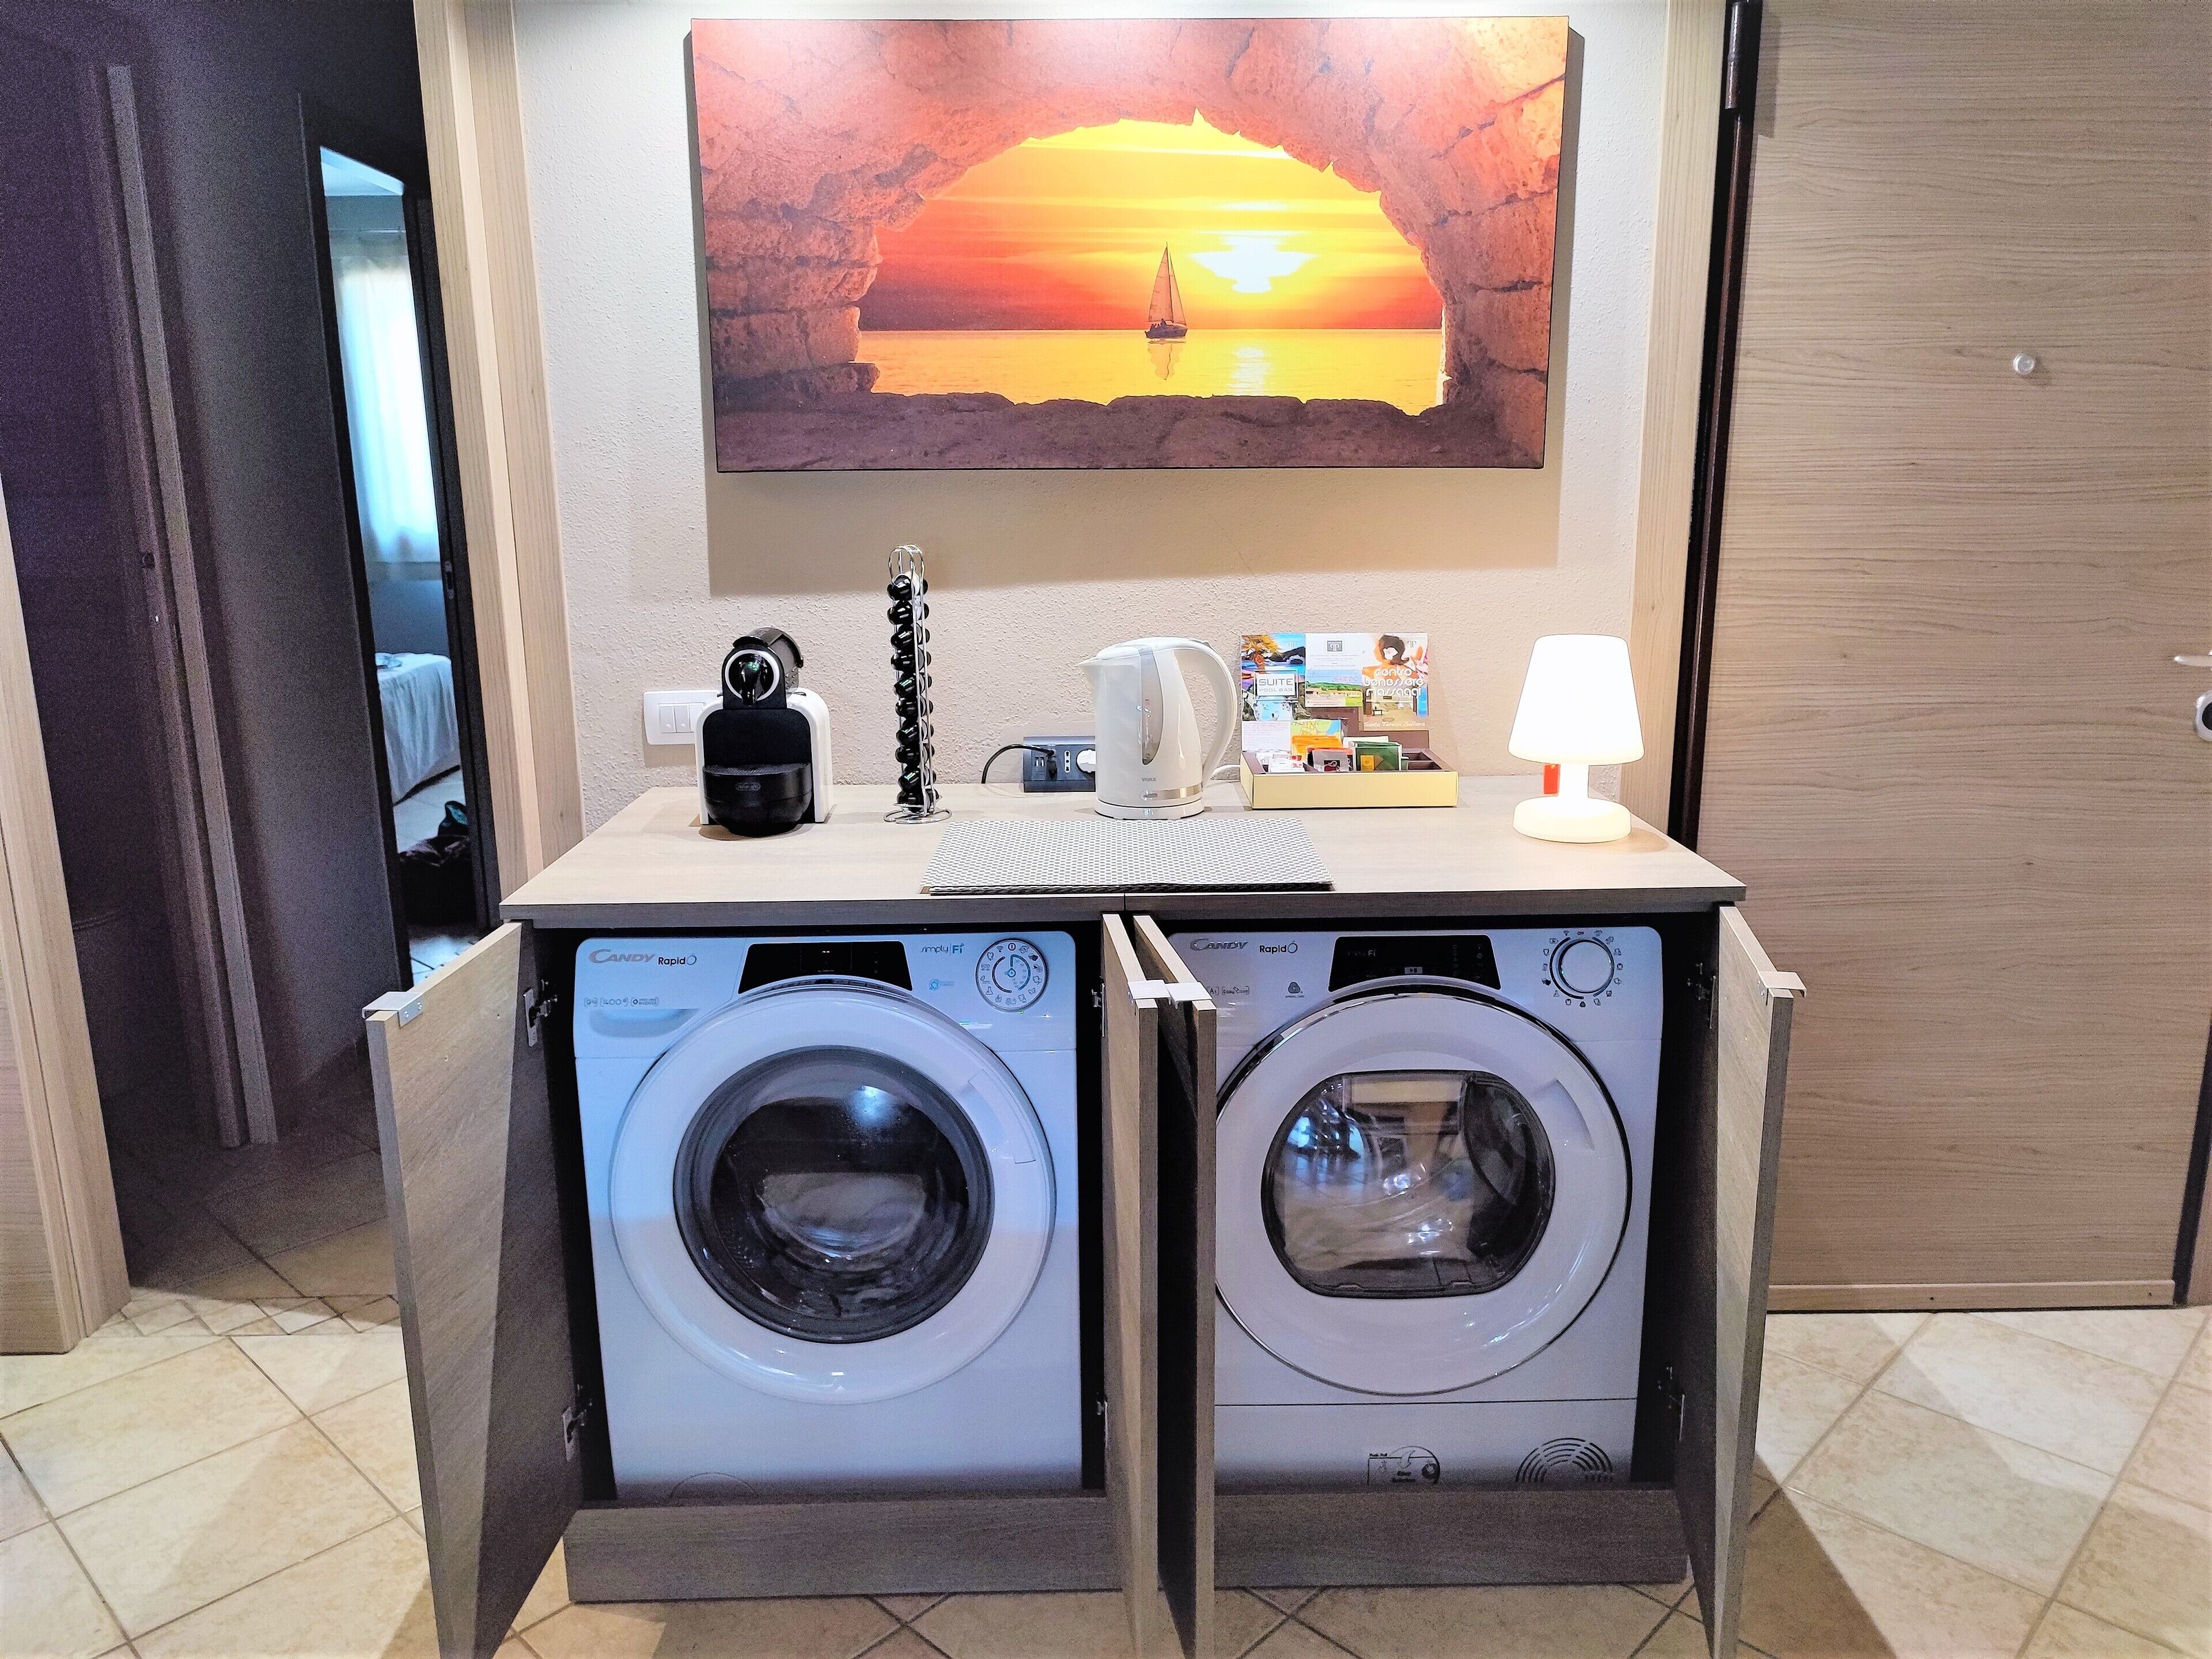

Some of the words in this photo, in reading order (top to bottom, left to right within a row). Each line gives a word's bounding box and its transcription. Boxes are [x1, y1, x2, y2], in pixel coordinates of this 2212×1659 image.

[1259, 678, 1294, 686] SUITE
[921, 945, 949, 953] simply
[952, 943, 964, 953] Fi
